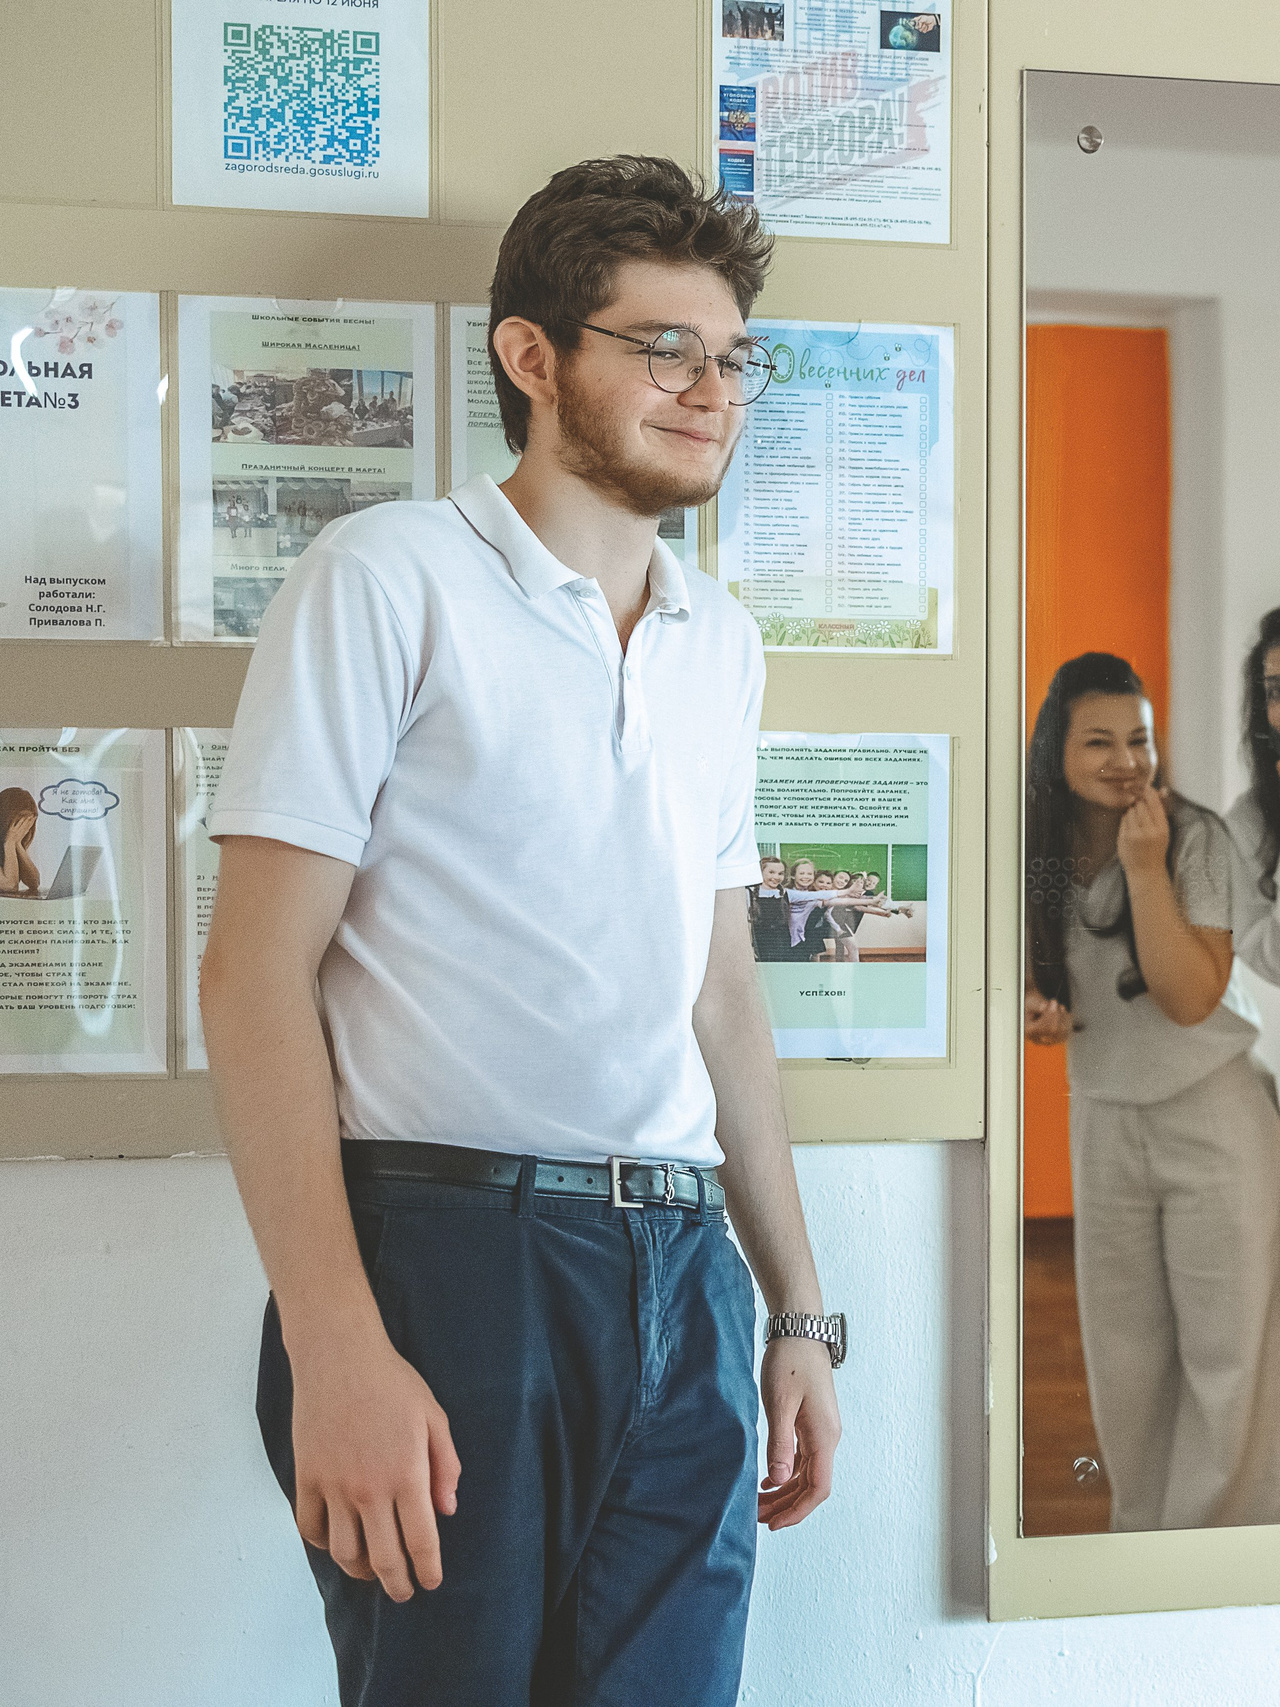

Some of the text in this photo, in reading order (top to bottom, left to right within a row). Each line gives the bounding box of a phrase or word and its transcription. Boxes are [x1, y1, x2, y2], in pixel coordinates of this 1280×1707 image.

[224, 161, 380, 180] zagorodsreda.gosuslugi.ru
[251, 314, 299, 322] ШКОЛЬНЫЕ
[301, 316, 341, 324] СОБЫТИЯ
[261, 341, 360, 351] ШИРОКАЯ МАСЛЕНИЦА!
[800, 347, 890, 382] весенних
[896, 369, 926, 391] дел
[241, 463, 305, 471] ПРАЗДНИЧНЫЙ
[308, 465, 345, 473] КОНЦЕРТ
[24, 575, 106, 587] Над выпуском
[38, 589, 96, 601] работали:
[28, 603, 106, 614] Солодова Н.Г.
[29, 617, 106, 629] Привалова П.
[18, 744, 58, 753] ПРОЙТИ
[799, 989, 847, 997] УСПЕХОВ!
